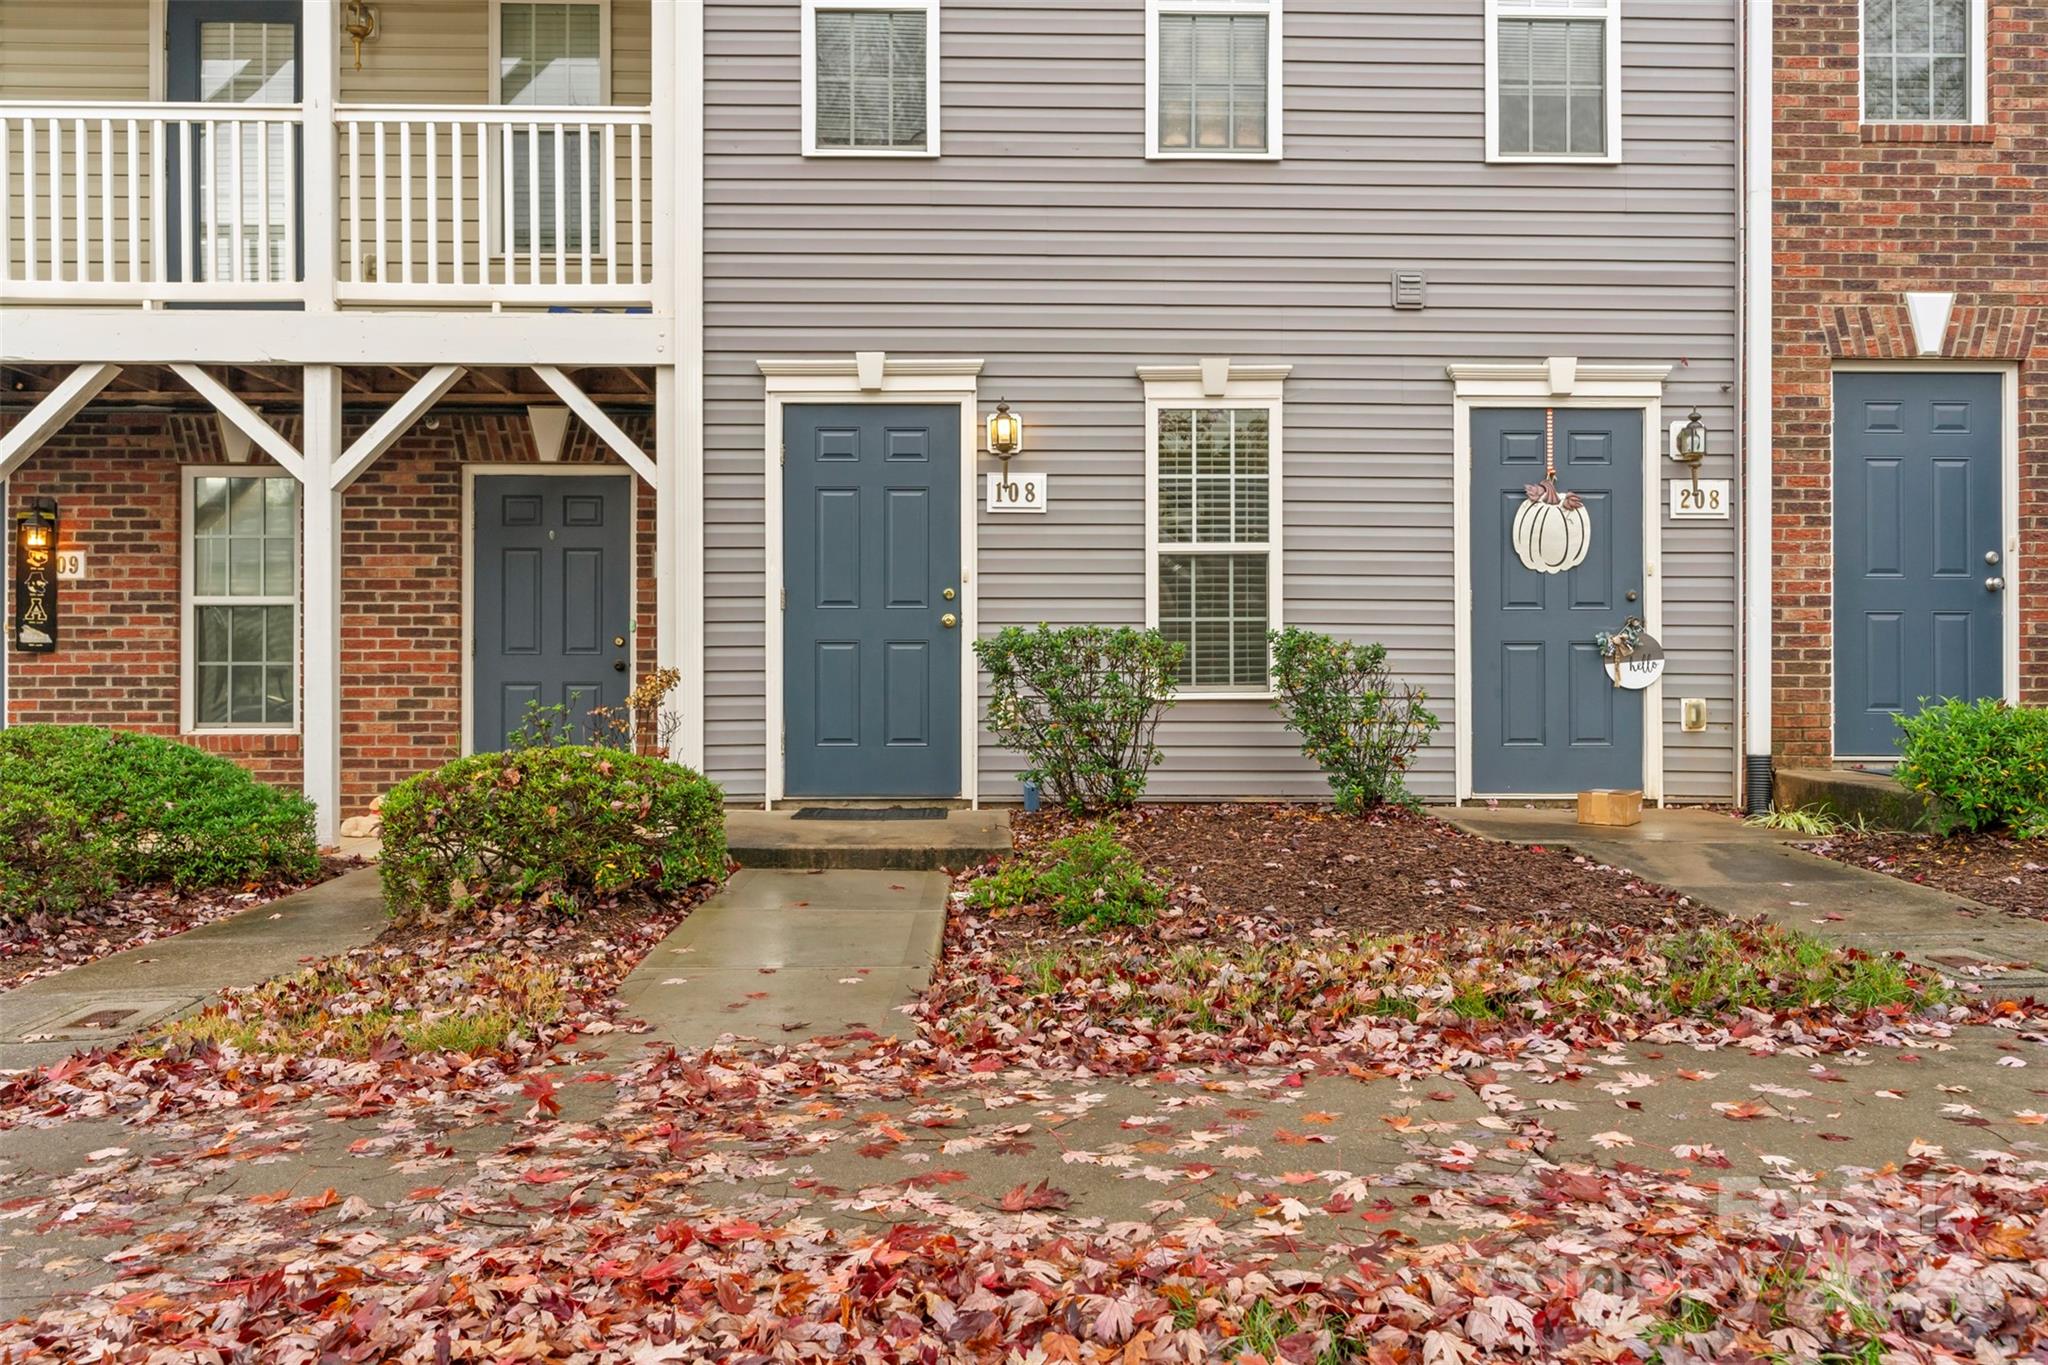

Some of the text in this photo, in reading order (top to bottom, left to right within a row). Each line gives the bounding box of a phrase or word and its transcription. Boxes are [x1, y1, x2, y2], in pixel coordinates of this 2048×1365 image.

[996, 482, 1035, 502] 108
[1681, 489, 1719, 509] 208
[56, 556, 79, 574] 09
[1629, 654, 1658, 673] hello
